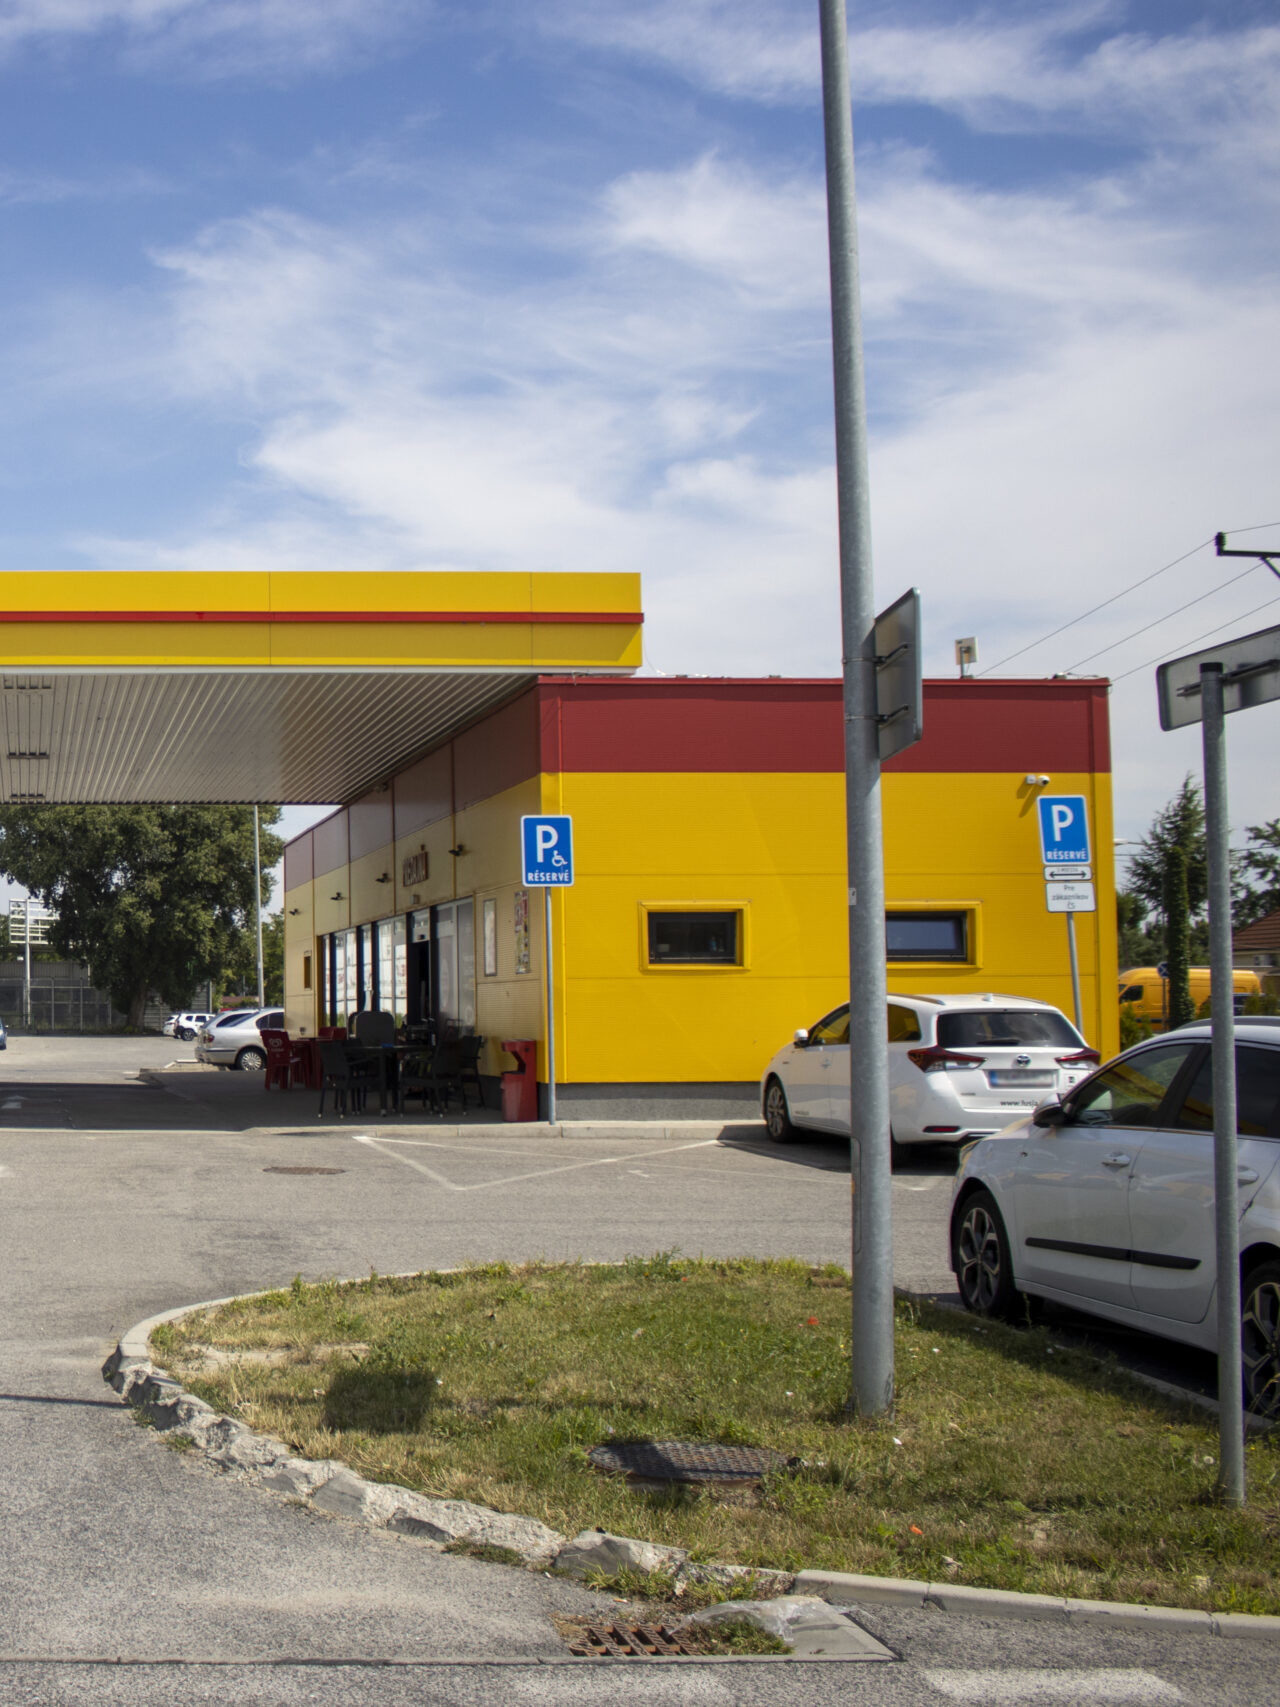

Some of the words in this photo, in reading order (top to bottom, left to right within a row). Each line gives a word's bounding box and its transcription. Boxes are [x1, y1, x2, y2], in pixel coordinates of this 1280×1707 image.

[1051, 804, 1074, 842] P
[535, 824, 559, 863] P
[1047, 849, 1087, 860] RÉSERVÉ
[527, 869, 570, 882] RÉSERVÉ
